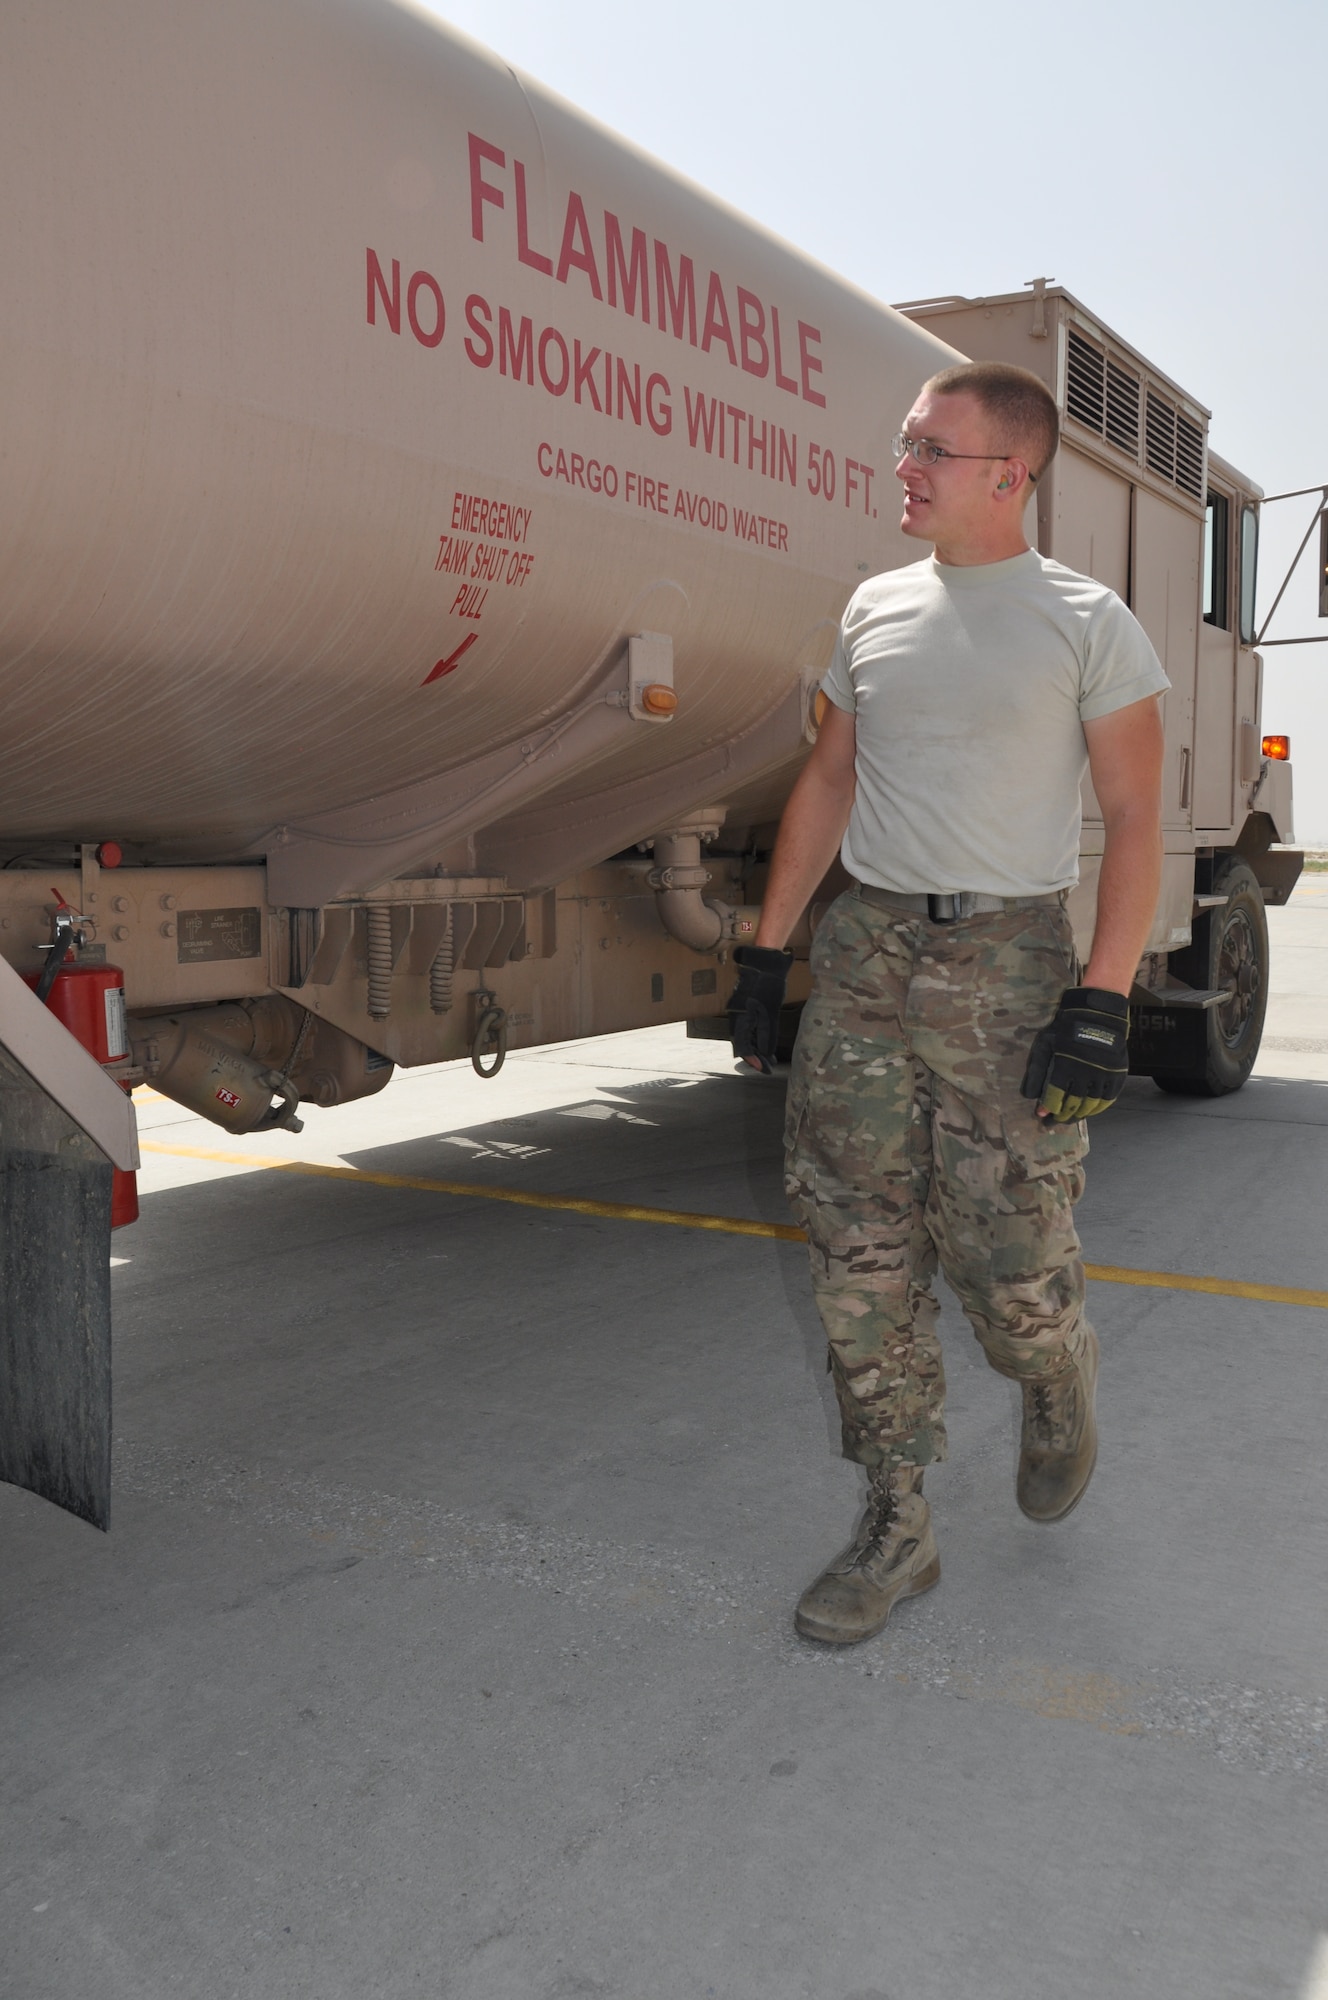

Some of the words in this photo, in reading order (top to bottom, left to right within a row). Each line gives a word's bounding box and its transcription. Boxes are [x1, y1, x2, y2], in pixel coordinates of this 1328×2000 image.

[467, 131, 827, 409] FLAMMABLE
[366, 247, 446, 349] NO
[463, 293, 673, 437] SMOKING
[683, 386, 797, 488] WITHIN
[807, 442, 836, 502] 50
[844, 457, 878, 519] FT.
[451, 492, 532, 543] EMERGENCY
[537, 442, 619, 497] CARGO
[625, 471, 669, 515] FIRE
[673, 489, 728, 533] AVOID
[733, 507, 789, 552] WATER
[434, 535, 474, 575] TANK
[470, 543, 509, 582] SHUT
[506, 551, 535, 587] OFF
[449, 583, 489, 619] PULL
[218, 1088, 241, 1108] TS-1
